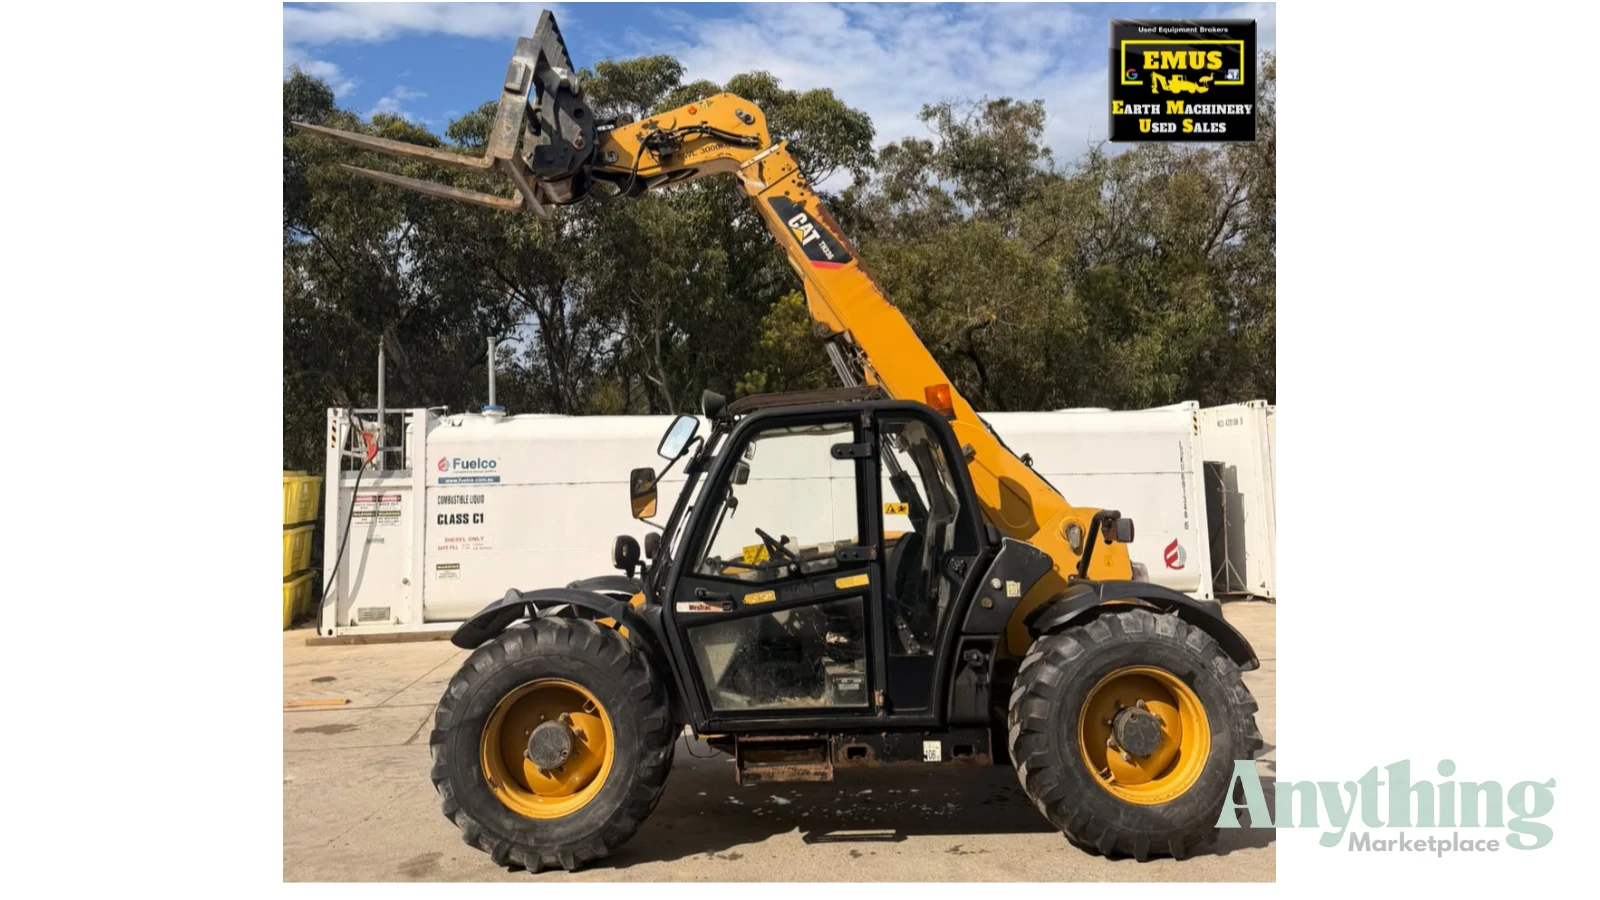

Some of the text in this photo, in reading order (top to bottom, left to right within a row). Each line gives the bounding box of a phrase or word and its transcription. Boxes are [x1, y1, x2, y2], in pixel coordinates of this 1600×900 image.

[788, 212, 821, 246] CAT
[452, 457, 497, 470] Fuelco
[437, 494, 485, 505] COMBUSTIBLE LIQUID
[437, 513, 484, 525] CLASS C1
